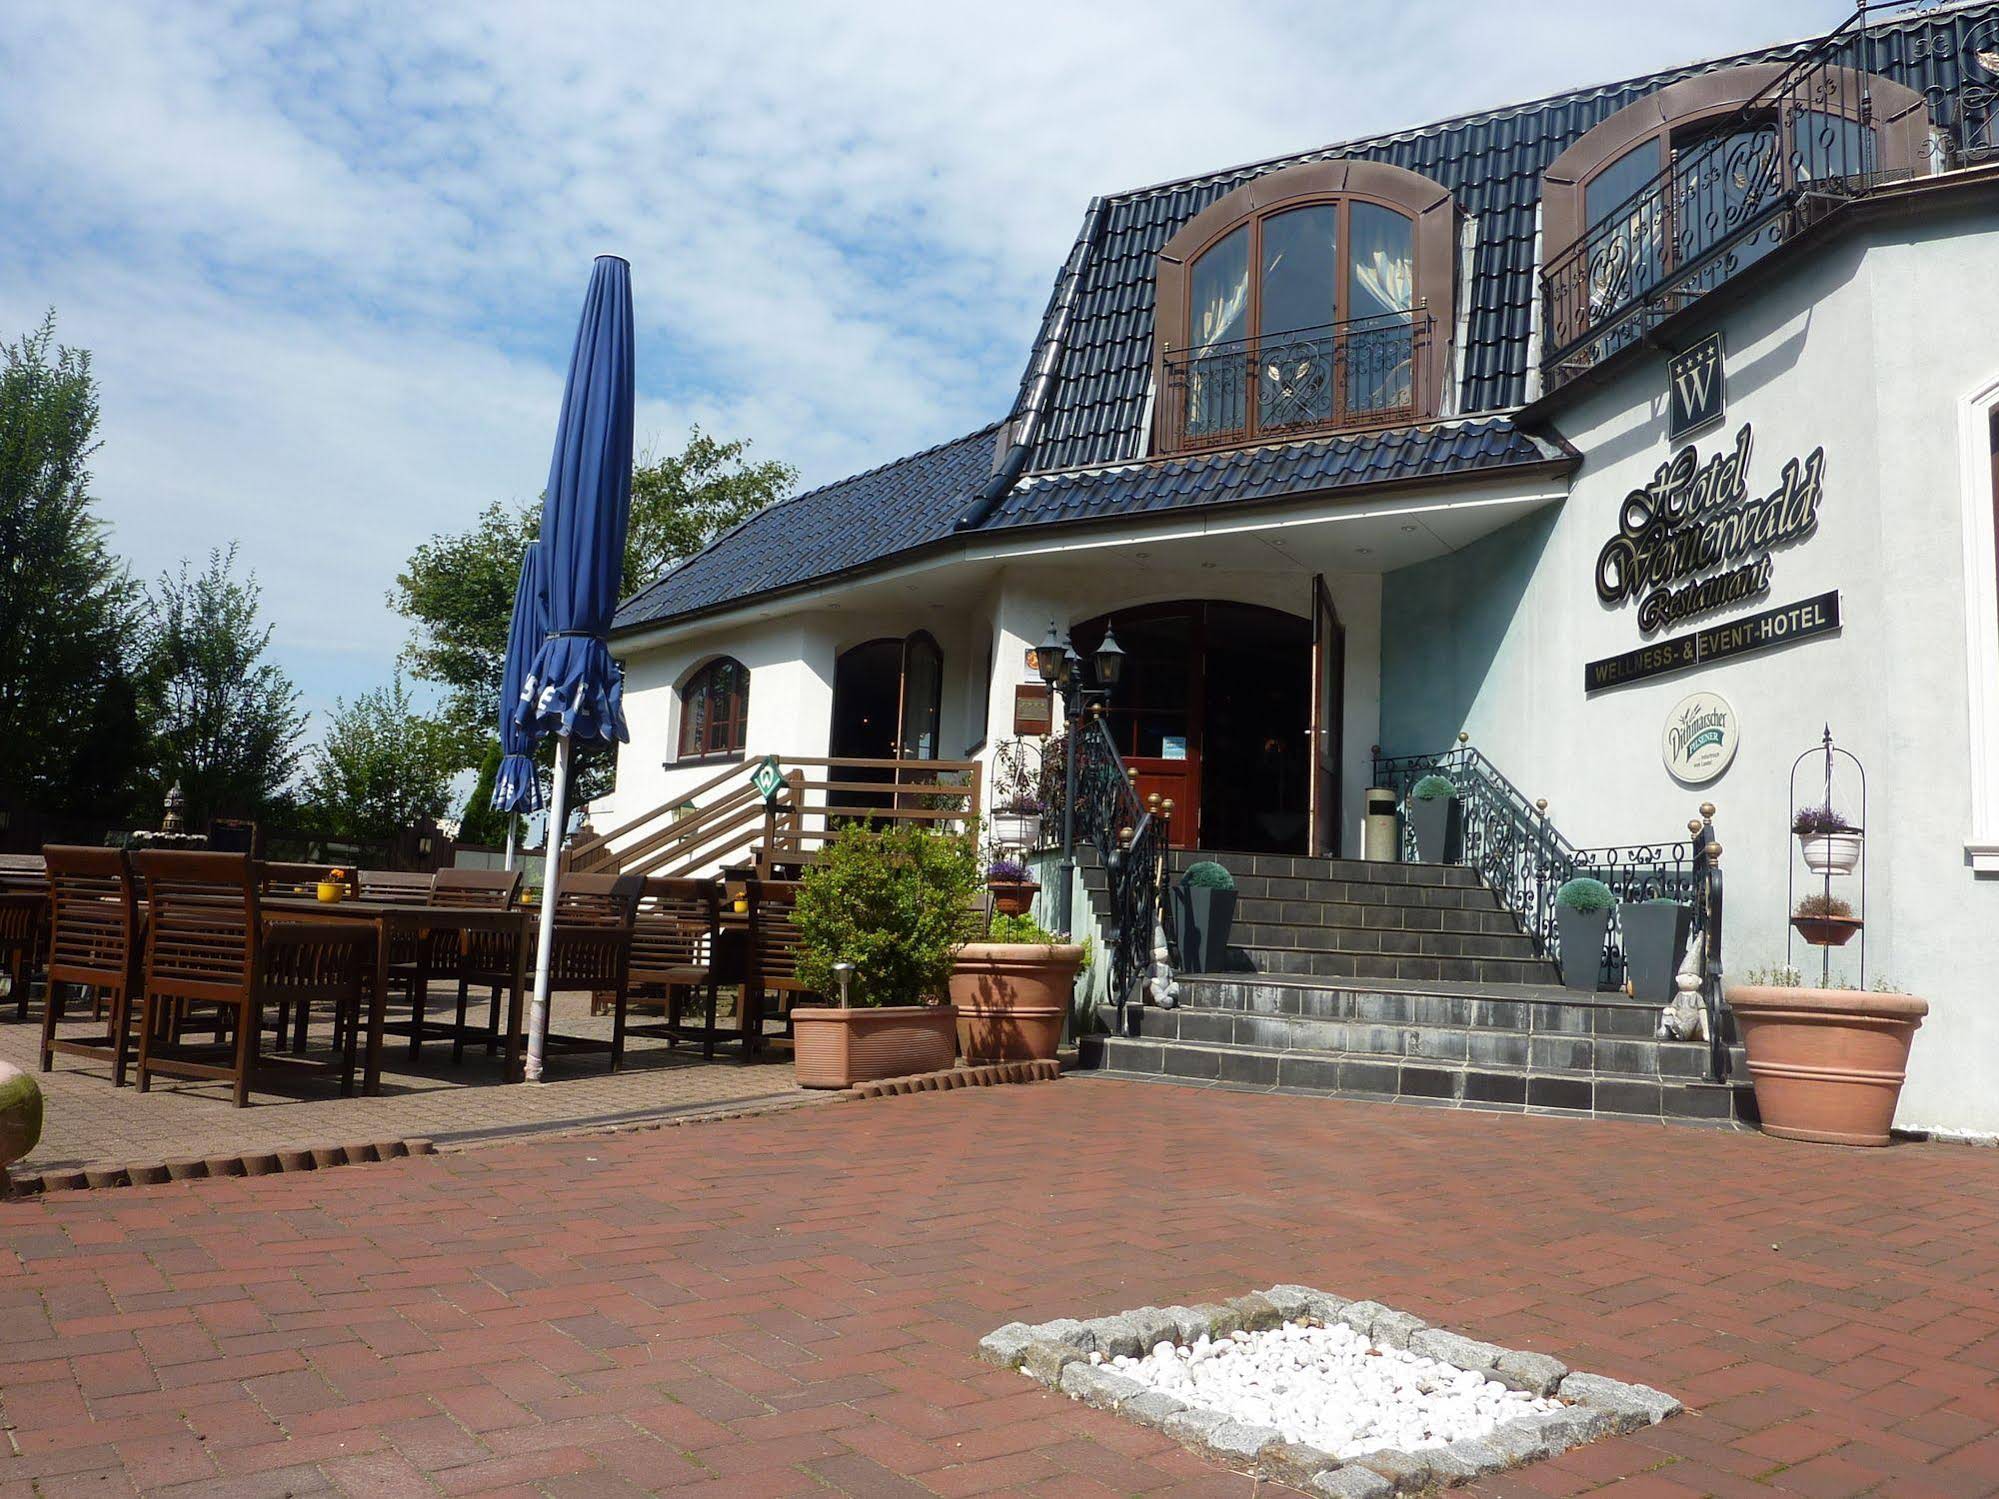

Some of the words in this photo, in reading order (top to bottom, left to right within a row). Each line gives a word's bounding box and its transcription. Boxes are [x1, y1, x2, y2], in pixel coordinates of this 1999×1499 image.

[1675, 357, 1717, 419] W
[1620, 424, 1751, 537] Hotel
[1596, 447, 1823, 602] Wernerwald
[1638, 553, 1771, 632] Restaurant
[1595, 645, 1678, 682] WELLNESS-
[1683, 640, 1694, 660] &
[1699, 603, 1826, 656] EVENT-HOTEL
[1668, 706, 1727, 764] Dithmarscher
